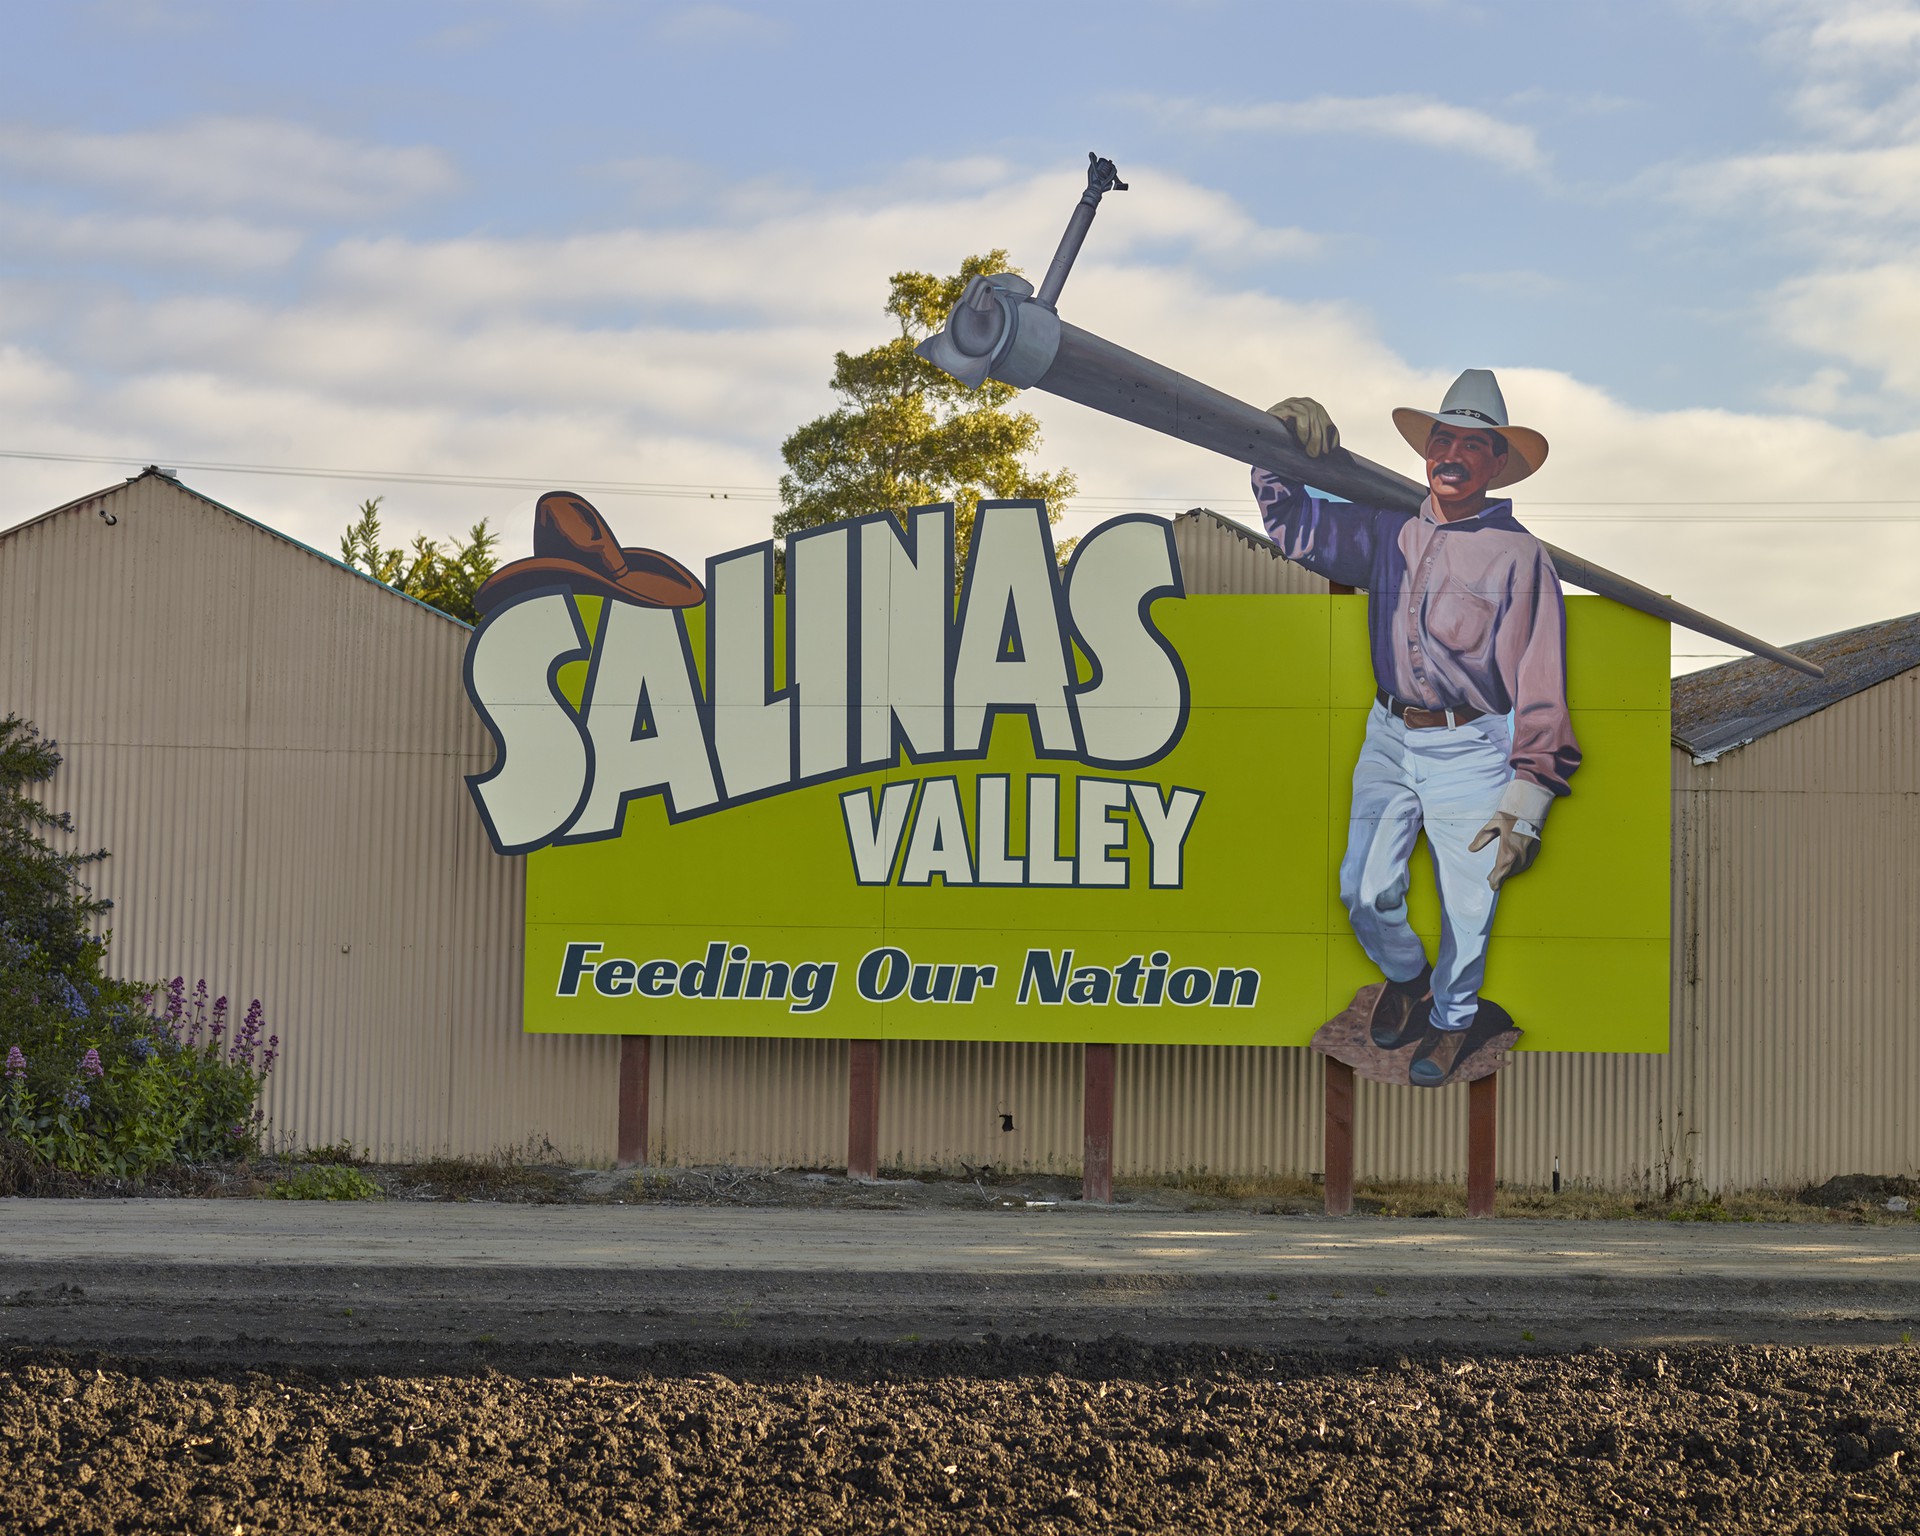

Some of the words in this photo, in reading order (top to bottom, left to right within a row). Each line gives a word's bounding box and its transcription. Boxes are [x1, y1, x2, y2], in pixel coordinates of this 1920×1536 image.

[464, 500, 1190, 856] SALINAS
[839, 774, 1205, 889] VALLEY
[556, 941, 838, 1014] Feeding
[856, 946, 996, 1005] Our
[1016, 948, 1261, 1011] Nation
